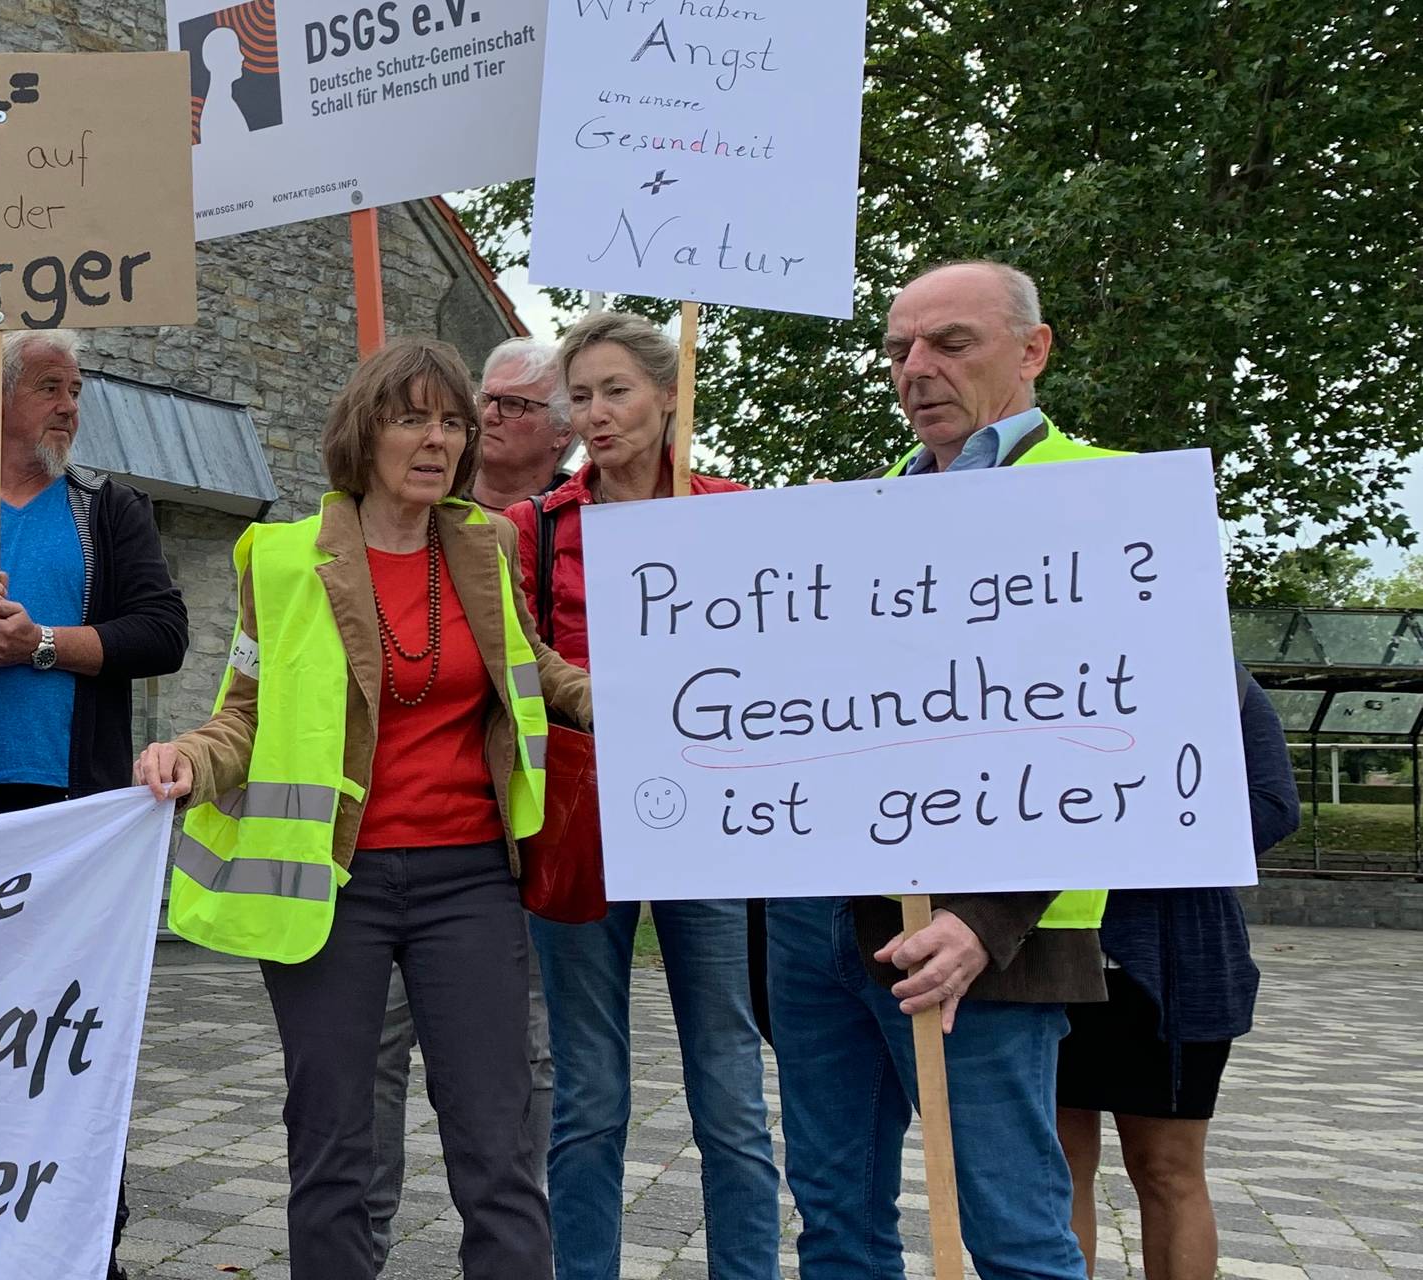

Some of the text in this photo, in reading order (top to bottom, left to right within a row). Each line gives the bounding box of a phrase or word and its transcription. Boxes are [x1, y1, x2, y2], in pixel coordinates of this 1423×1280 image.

[305, 0, 401, 64] DSGS
[679, 0, 766, 21] haben
[309, 25, 536, 95] Deutsche Schutz-Gemeinschaft
[630, 18, 780, 91] Angst
[311, 59, 506, 117] Schall für Mensch und Tier
[598, 89, 705, 111] um unsere
[27, 129, 94, 187] auf
[575, 115, 775, 160] Gesundheit
[3, 195, 66, 230] der
[195, 178, 358, 220] WWW.DSGS.INFO KONTAKT@DSGS.INFO
[587, 208, 805, 276] Natur
[631, 562, 832, 637] Profit
[870, 563, 938, 618] ist
[966, 551, 1083, 624] geil
[672, 653, 1138, 742] Gesundheit
[720, 781, 813, 836] ist
